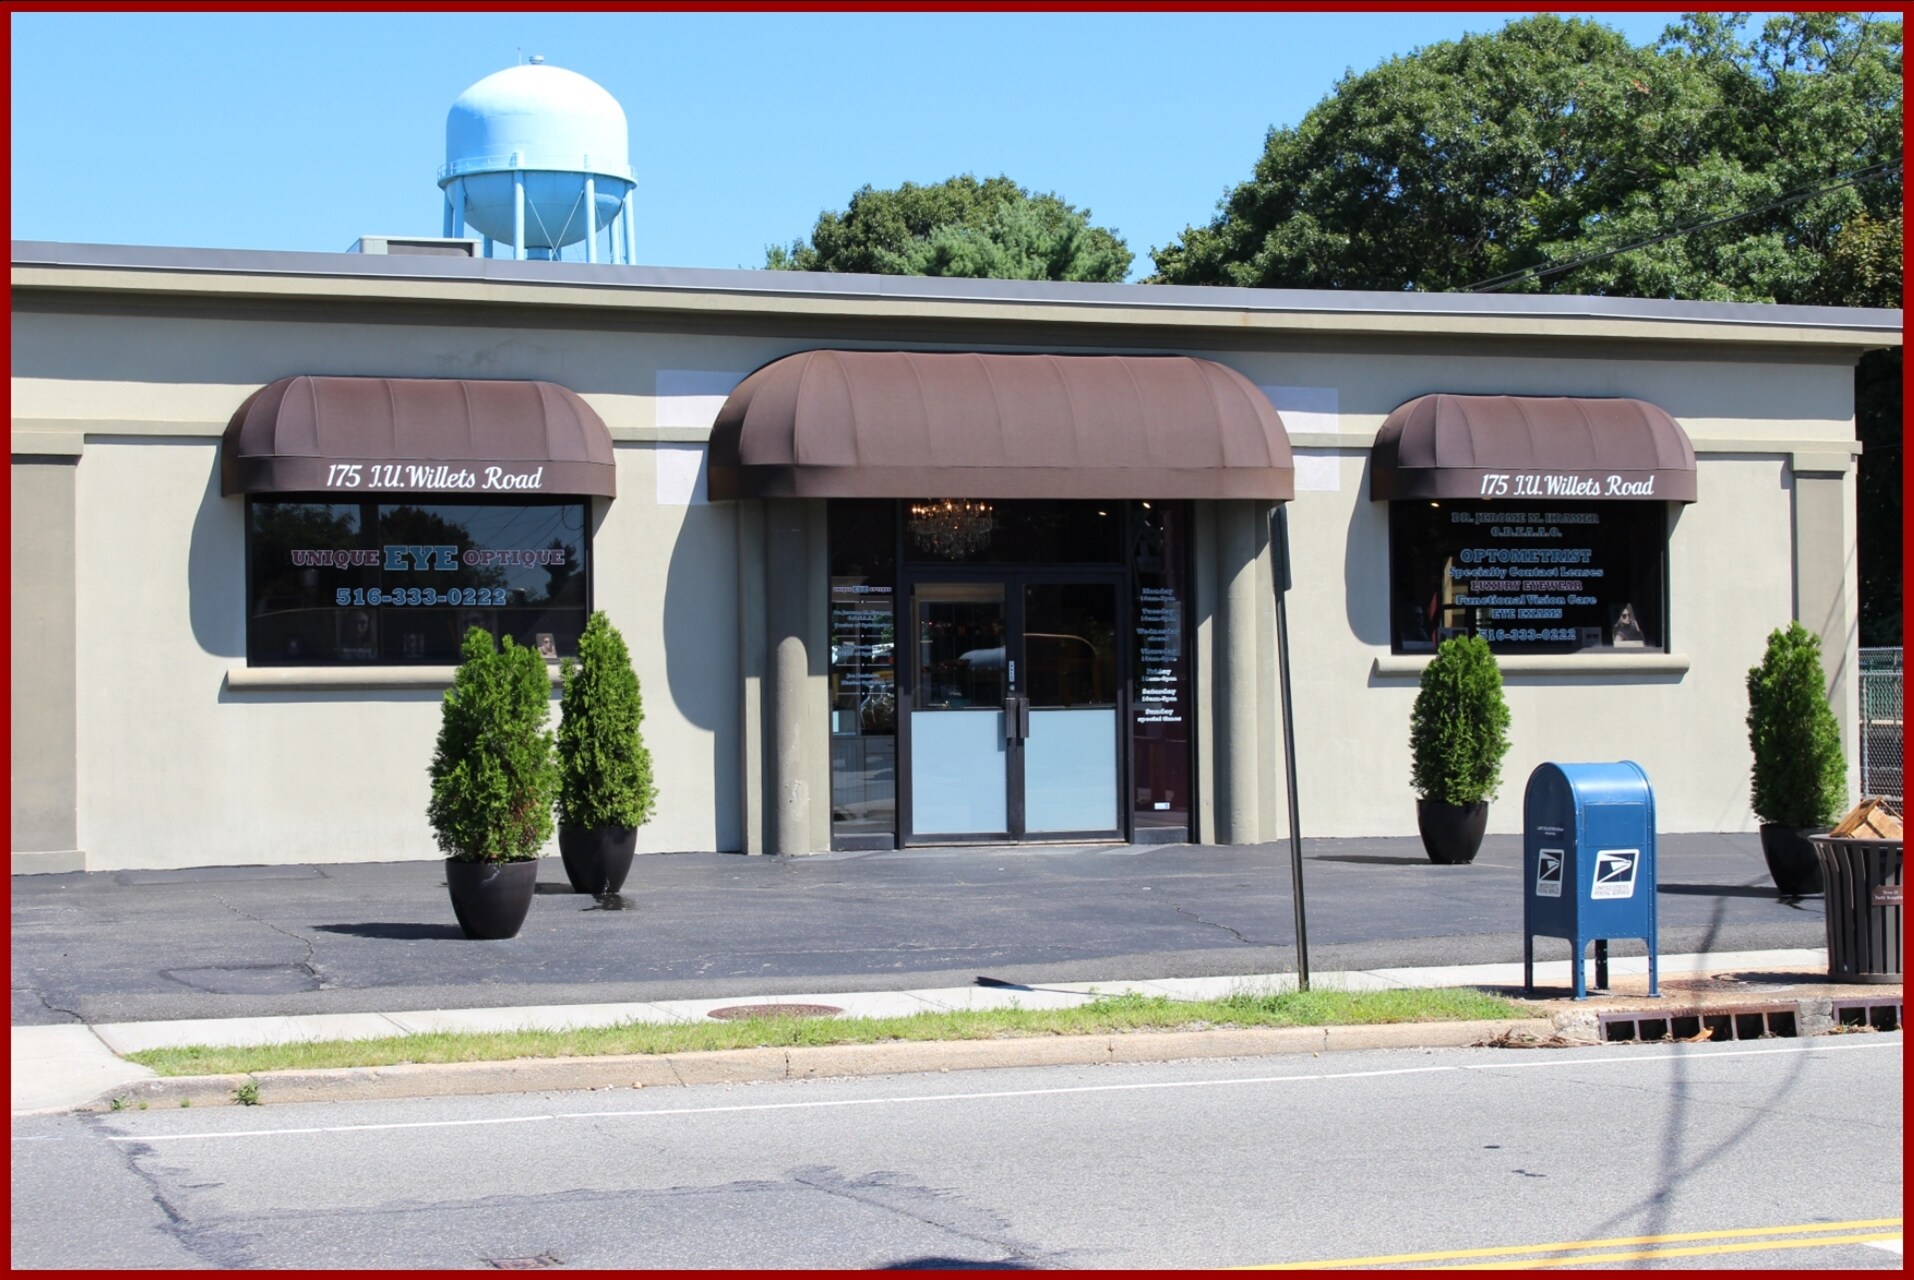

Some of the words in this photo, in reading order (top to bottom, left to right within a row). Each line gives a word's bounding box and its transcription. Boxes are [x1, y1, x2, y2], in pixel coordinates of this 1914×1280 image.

[327, 465, 362, 488] 175
[481, 466, 543, 489] Road
[1480, 474, 1509, 495] 175
[1604, 475, 1654, 496] Road
[1451, 512, 1474, 523] DR.
[1475, 512, 1526, 525] JEROME
[1527, 512, 1544, 523] M.
[1545, 512, 1600, 524] KRAMER
[291, 549, 380, 570] UNIQUE
[383, 545, 458, 571] EYE
[463, 548, 565, 570] OPTIQUE
[1460, 548, 1592, 563] OPTOMETRIST
[1449, 566, 1507, 579] Specialty
[1509, 566, 1558, 577] Contact
[1560, 567, 1604, 577] Lenses
[1470, 580, 1521, 591] LUXURY
[1522, 580, 1584, 591] EYEWEAR
[335, 587, 507, 606] 516-333-0222
[1455, 594, 1526, 605] Functional
[1526, 594, 1566, 605] Vision
[1567, 594, 1597, 605] Care
[1492, 608, 1516, 619] EYE
[1517, 608, 1563, 619] EXAMS
